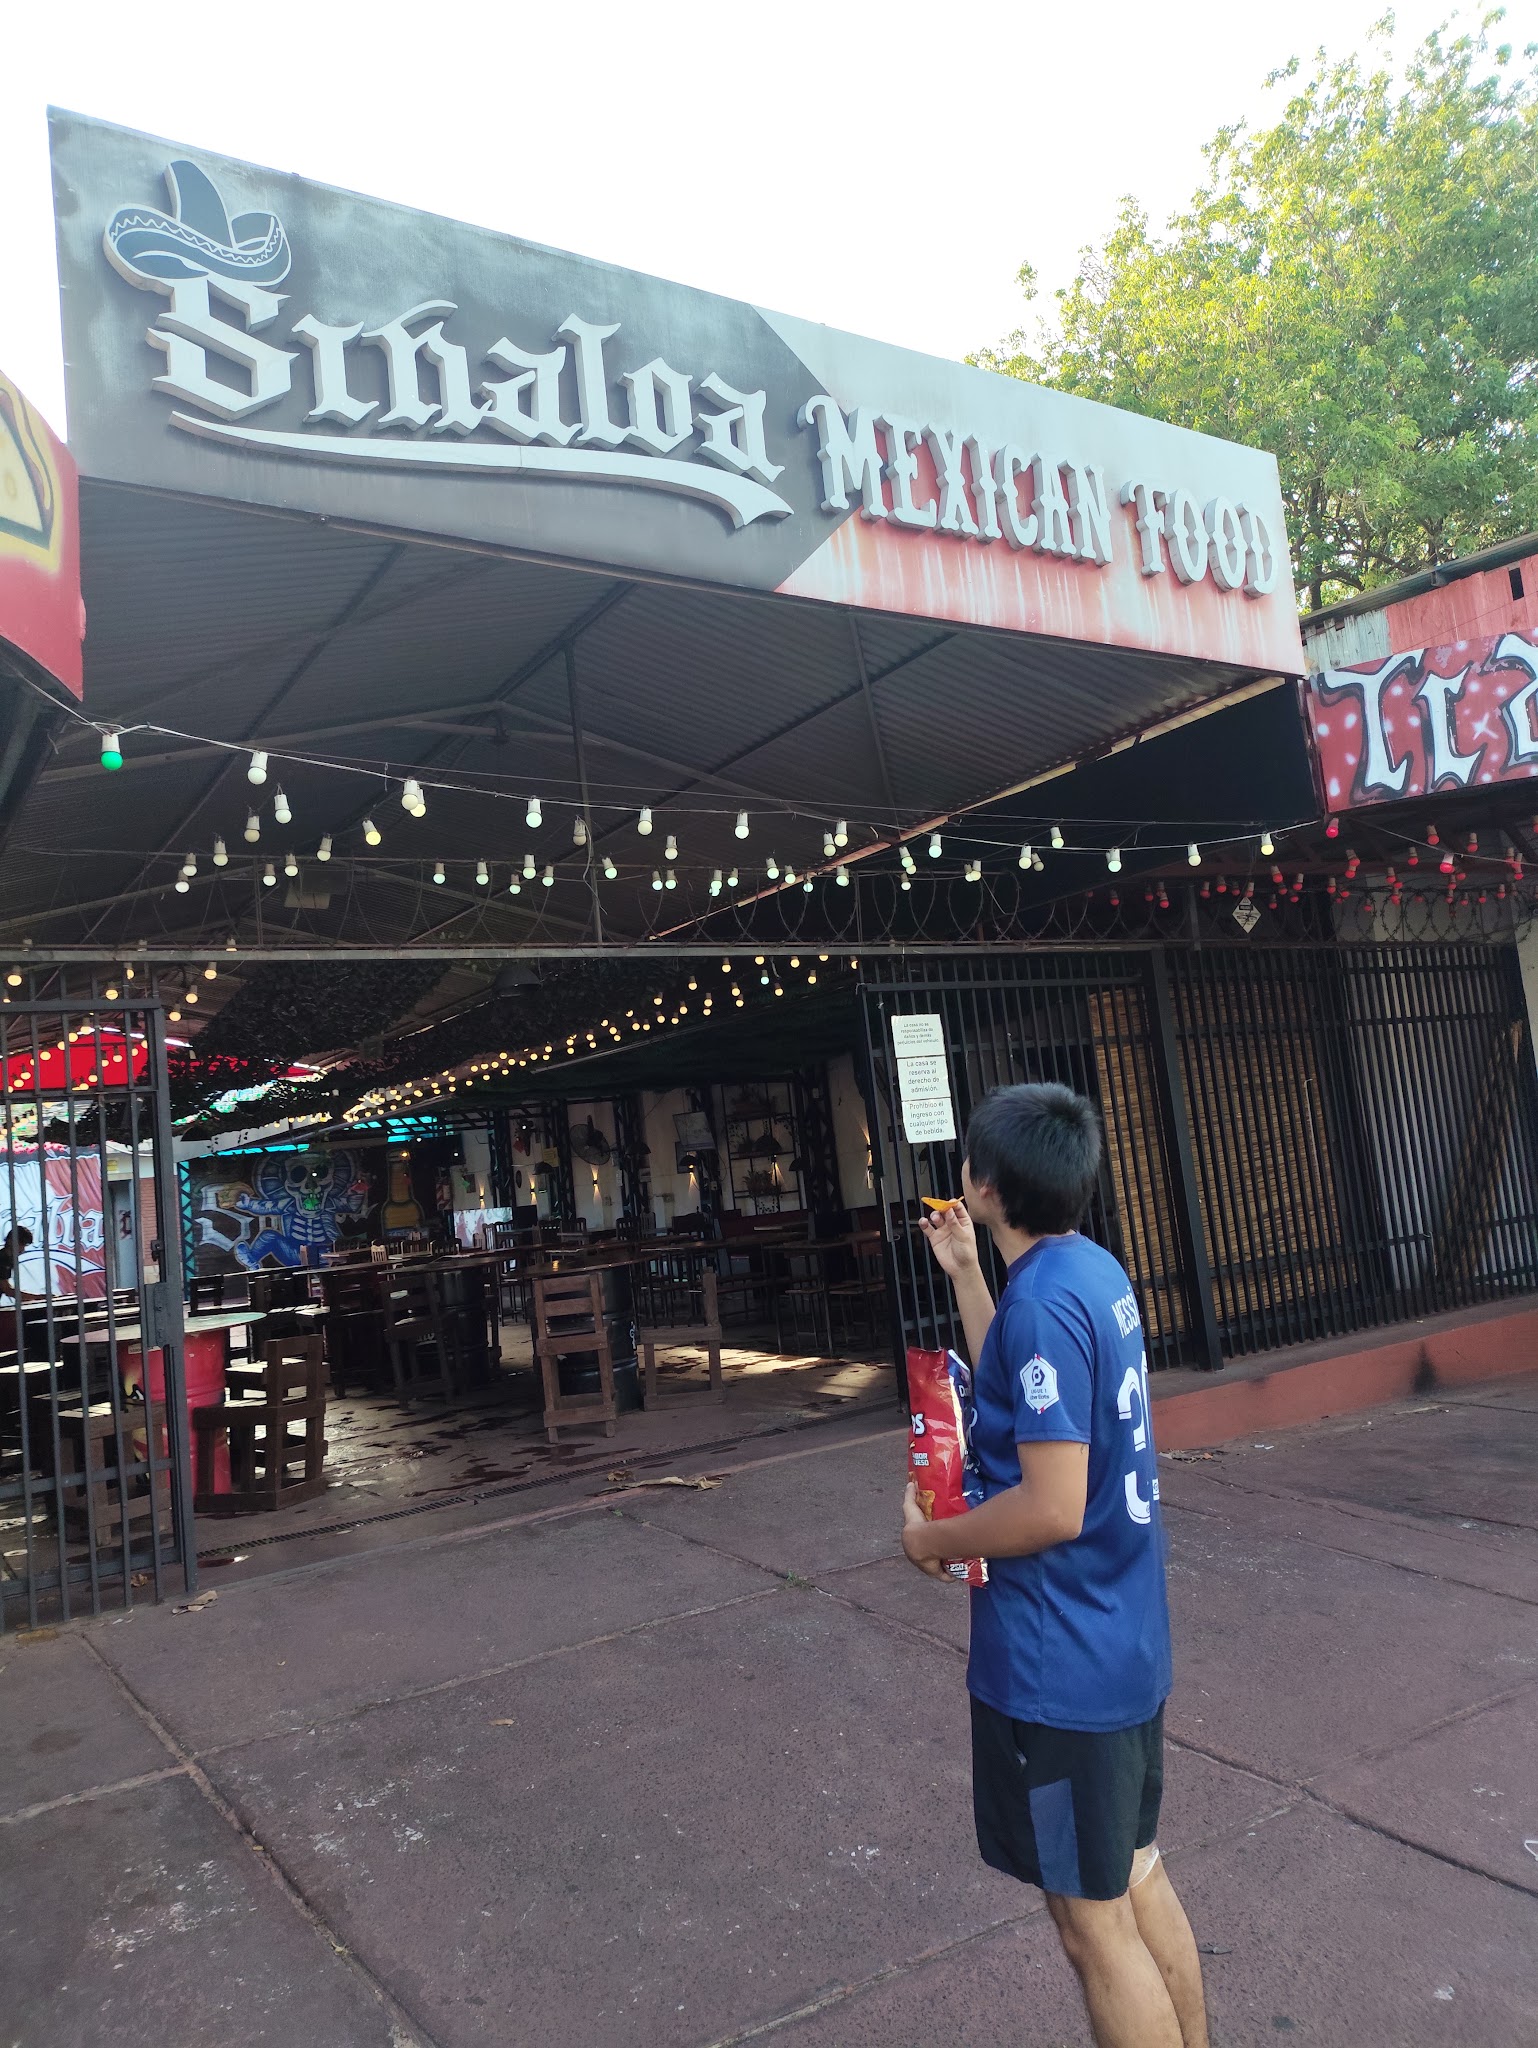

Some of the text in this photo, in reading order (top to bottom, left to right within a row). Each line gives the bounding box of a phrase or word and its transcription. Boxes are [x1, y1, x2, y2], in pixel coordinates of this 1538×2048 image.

[146, 274, 788, 485] Sinaloa
[797, 394, 1279, 599] MEXICAN FOOD
